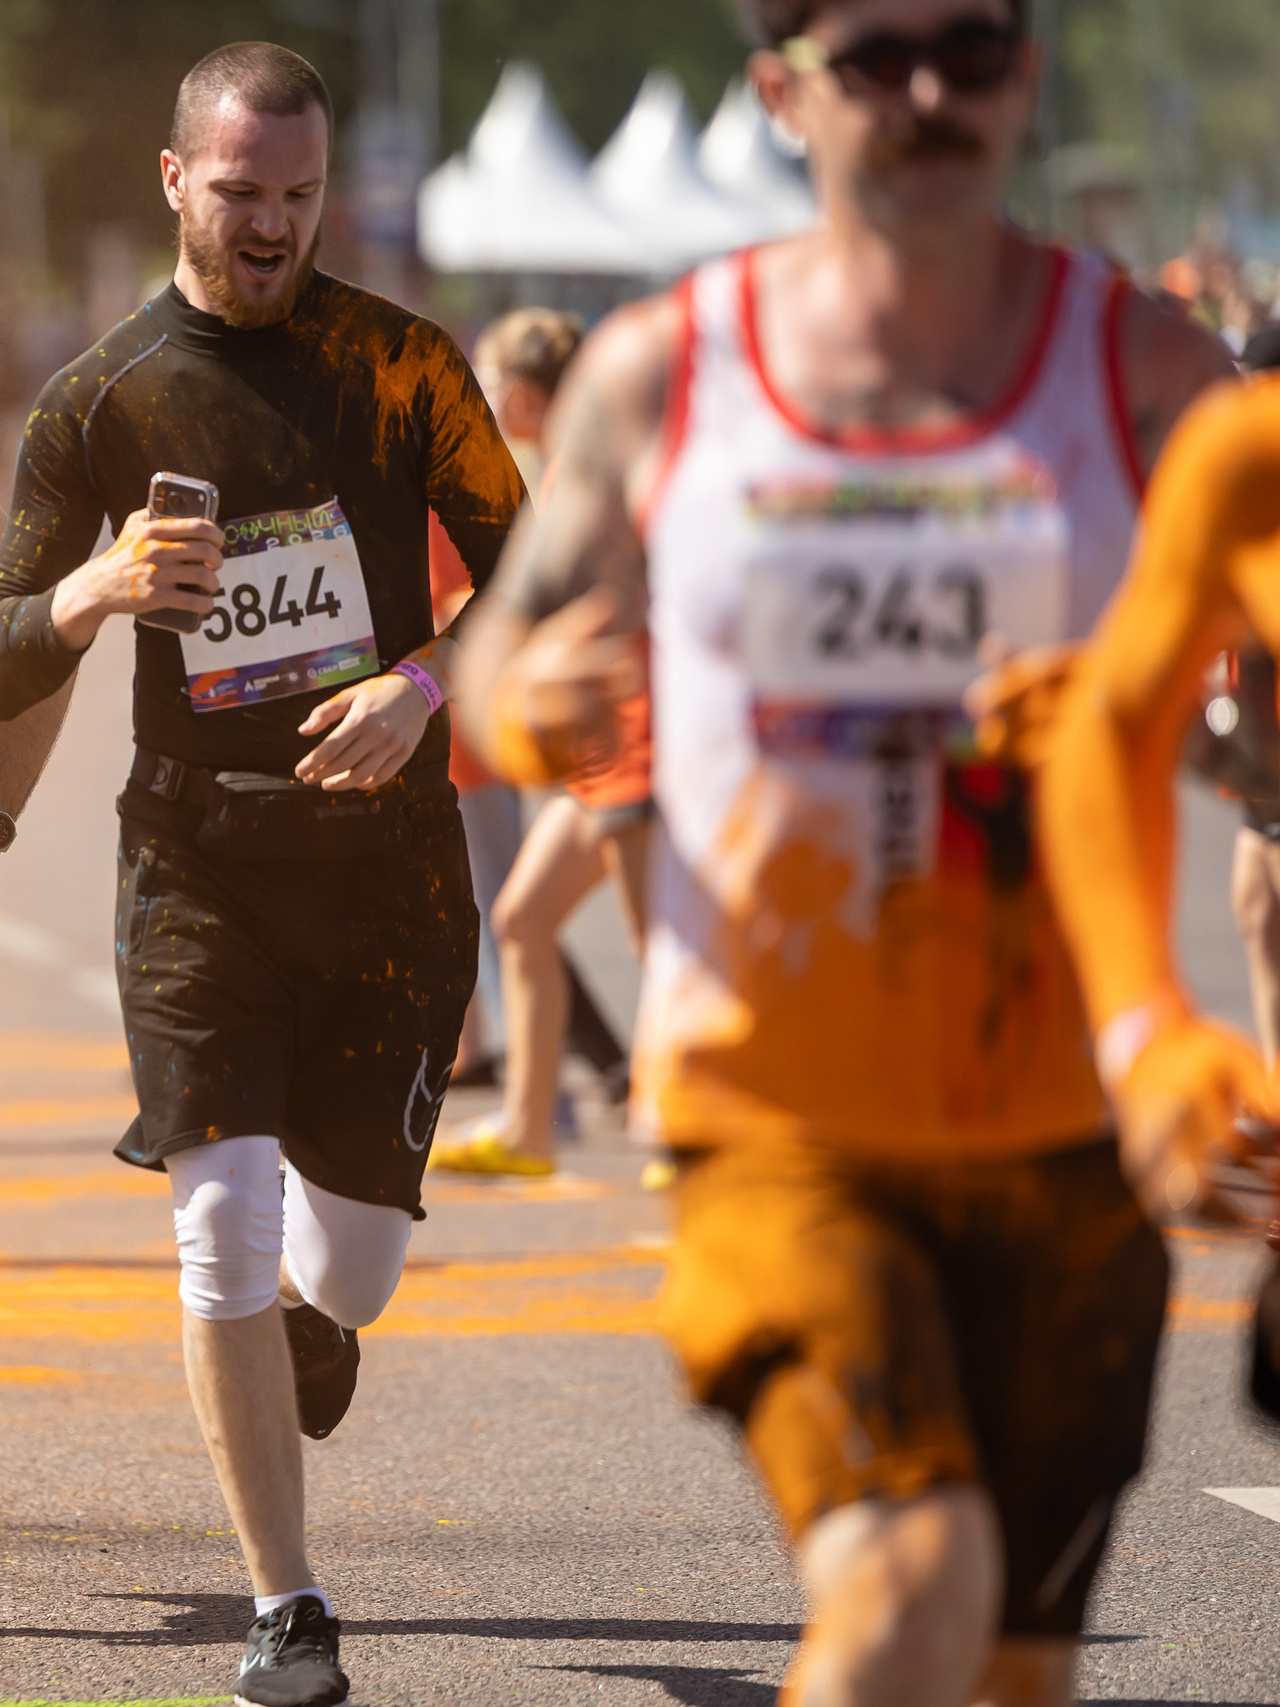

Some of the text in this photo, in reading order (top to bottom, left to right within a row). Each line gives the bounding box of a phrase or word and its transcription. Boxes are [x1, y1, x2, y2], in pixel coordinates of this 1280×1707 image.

[223, 508, 333, 545] СОЧНЫЙ
[266, 525, 348, 550] 2026
[203, 566, 342, 643] 5844
[812, 563, 986, 661] 243
